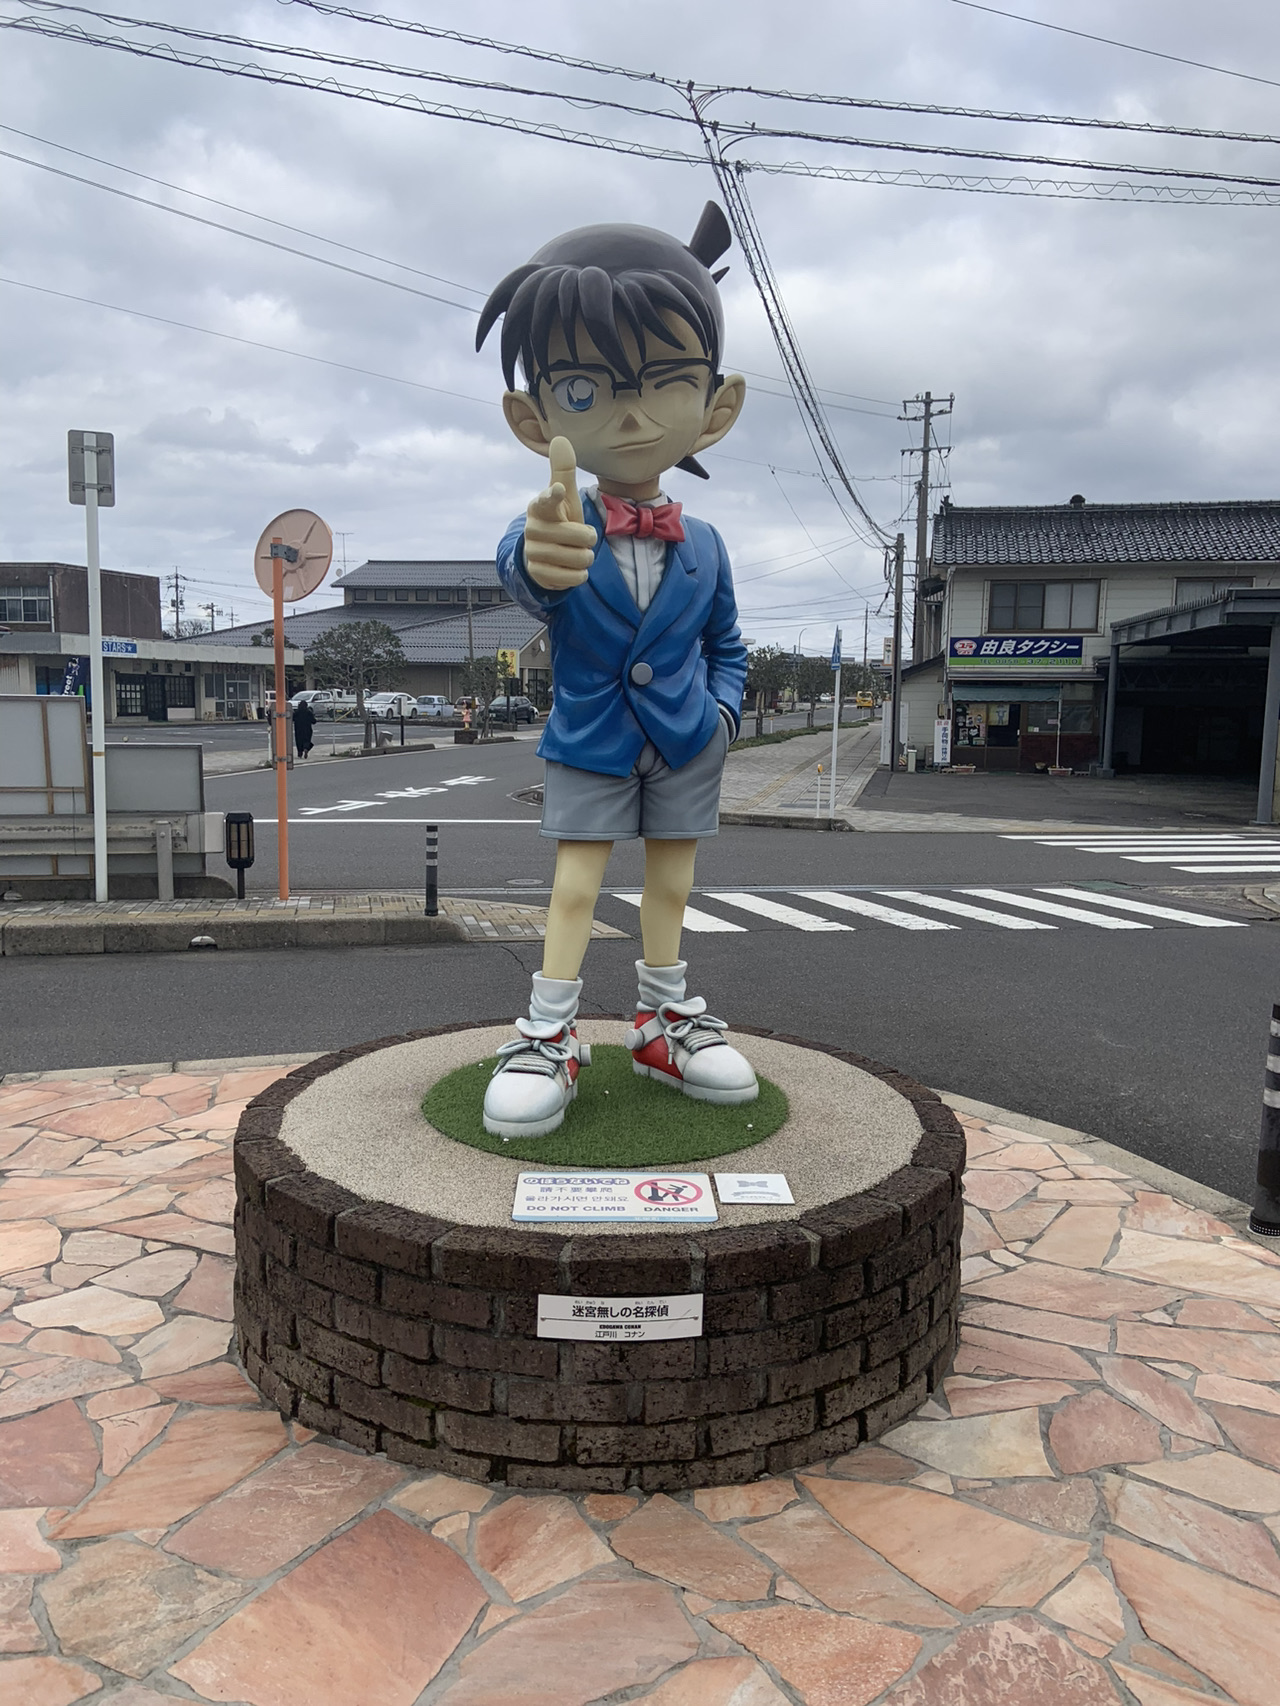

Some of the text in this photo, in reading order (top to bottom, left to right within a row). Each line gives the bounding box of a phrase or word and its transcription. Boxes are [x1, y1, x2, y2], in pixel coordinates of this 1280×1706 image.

[103, 642, 126, 653] STARS
[980, 639, 1080, 655] 由良タクシー
[572, 1305, 669, 1318] 迷宮無しの名探偵
